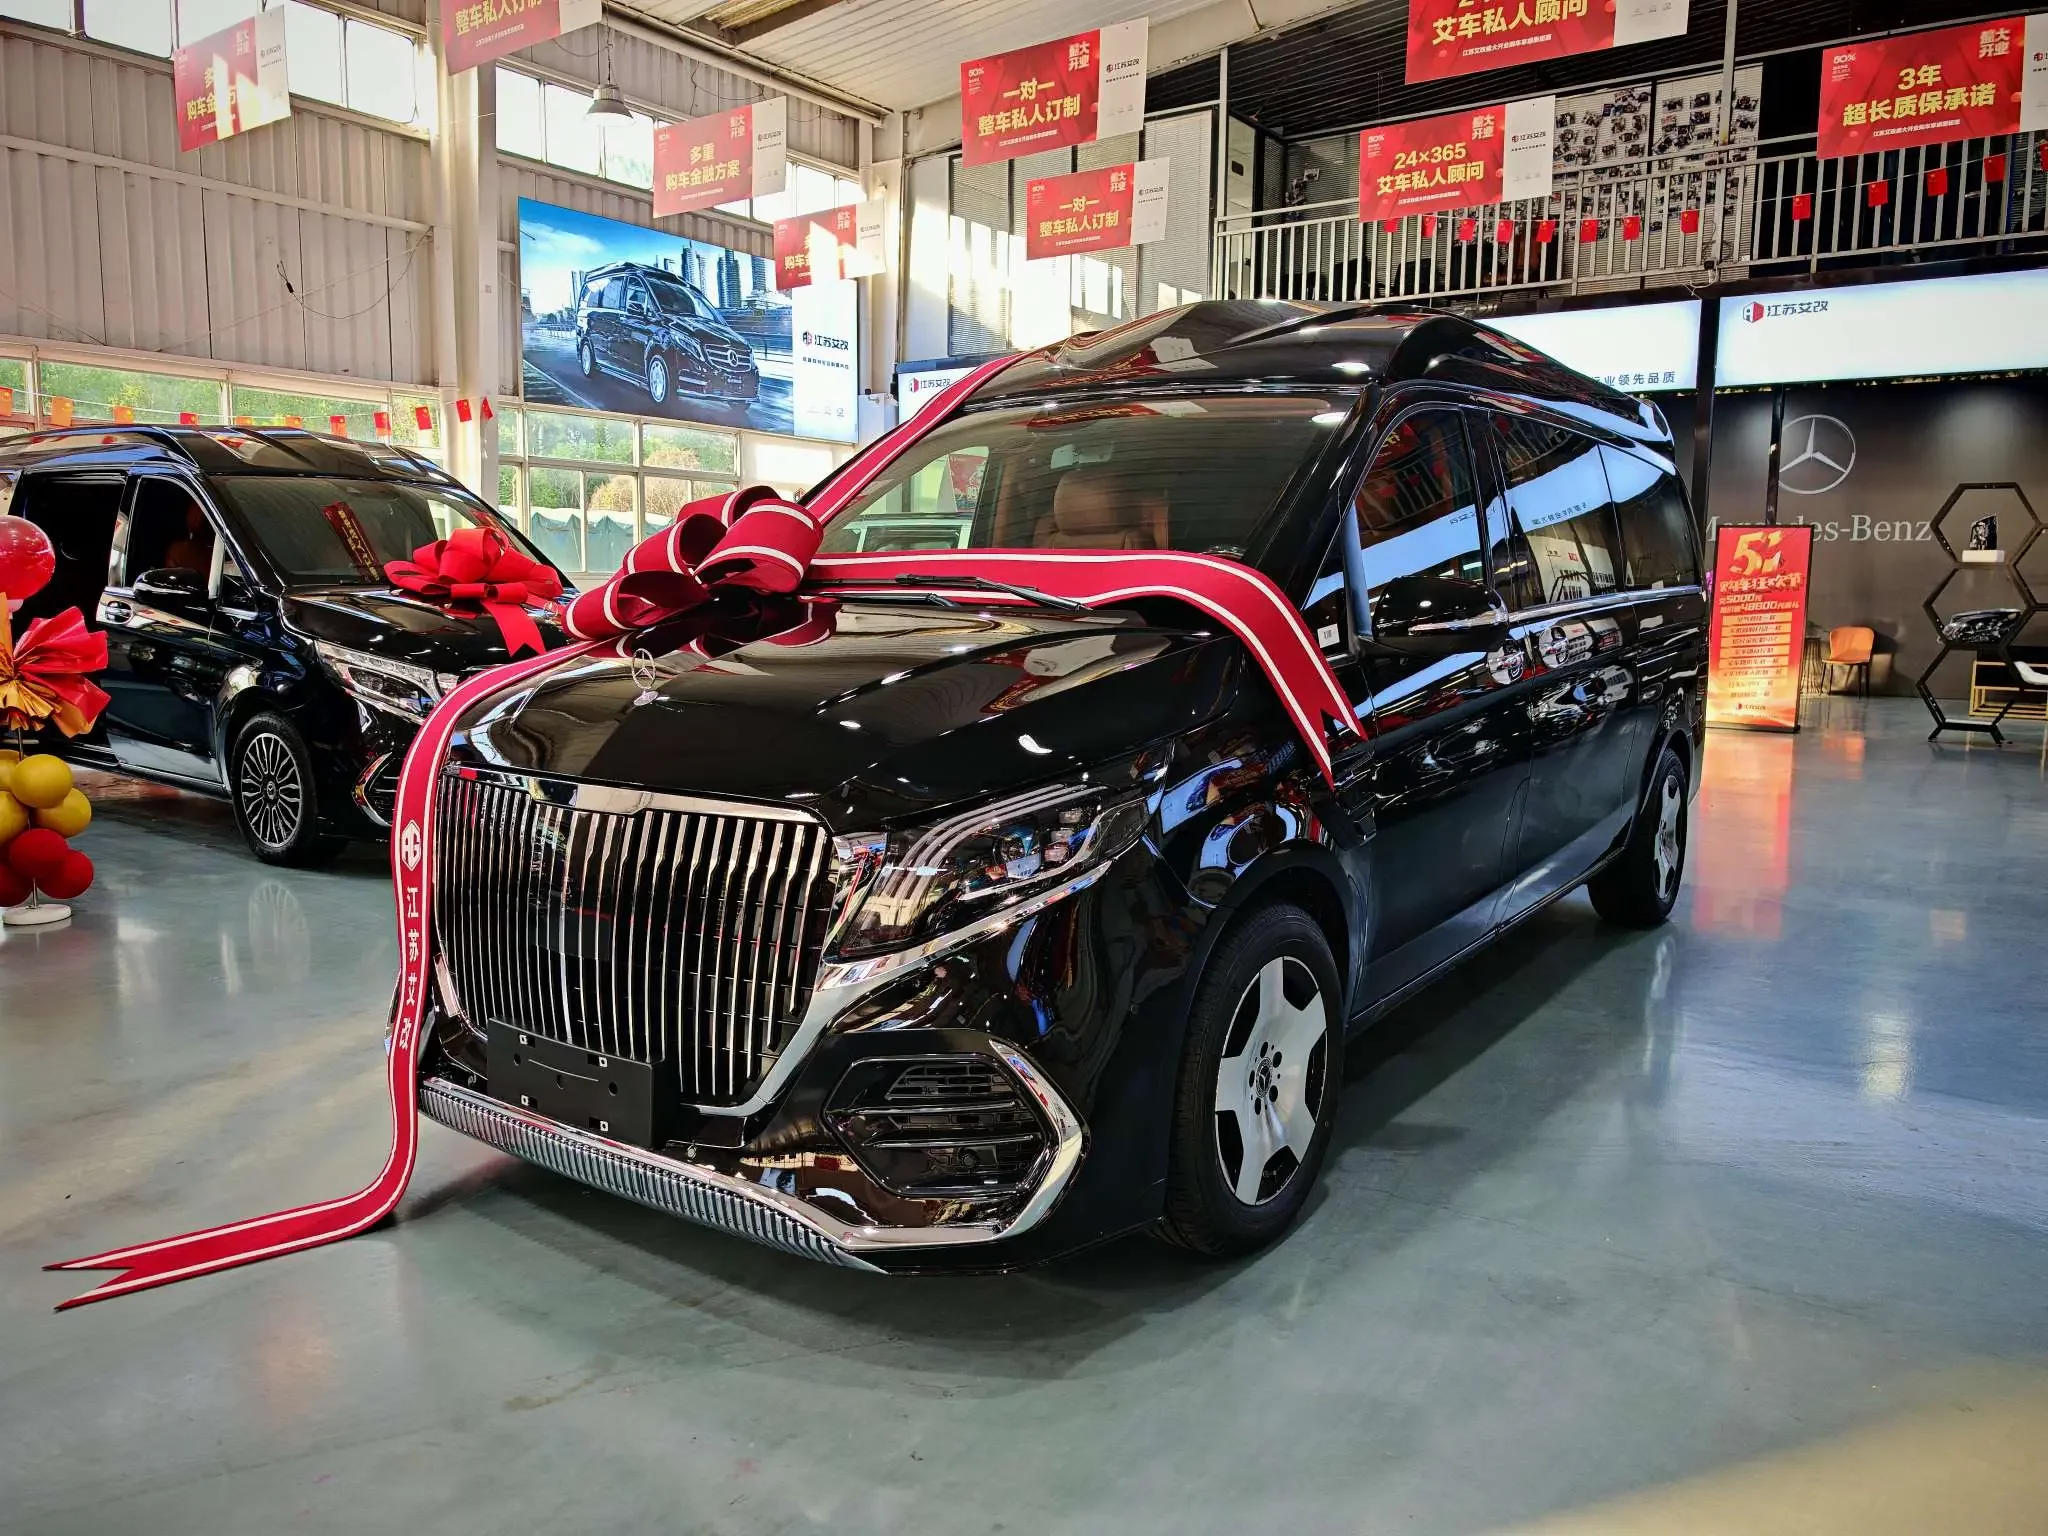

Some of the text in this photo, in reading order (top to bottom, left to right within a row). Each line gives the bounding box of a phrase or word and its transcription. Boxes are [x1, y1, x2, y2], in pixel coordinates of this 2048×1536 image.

[1432, 0, 1588, 45] 艾车私人顾问
[1979, 27, 2011, 45] 盛大
[1979, 42, 2011, 59] 开业
[1068, 56, 1090, 71] 开业
[1003, 77, 1055, 101] 一对一
[1898, 64, 1941, 90] 3年
[978, 94, 1081, 137] 整车私人订制
[1842, 81, 1996, 128] 超长质保承诺
[1472, 127, 1495, 141] 开业
[690, 142, 714, 166] 多重
[665, 160, 740, 192] 购车金融方案
[1377, 161, 1485, 196] 艾车私人顾问
[1059, 196, 1100, 213] 一对一
[1039, 210, 1120, 238] 整车私人订制
[1767, 300, 1829, 317] 江苏艾改
[814, 334, 849, 351] 江苏艾改
[1704, 514, 1933, 543] Mes-Benz
[399, 886, 420, 1051] 江苏艾改
